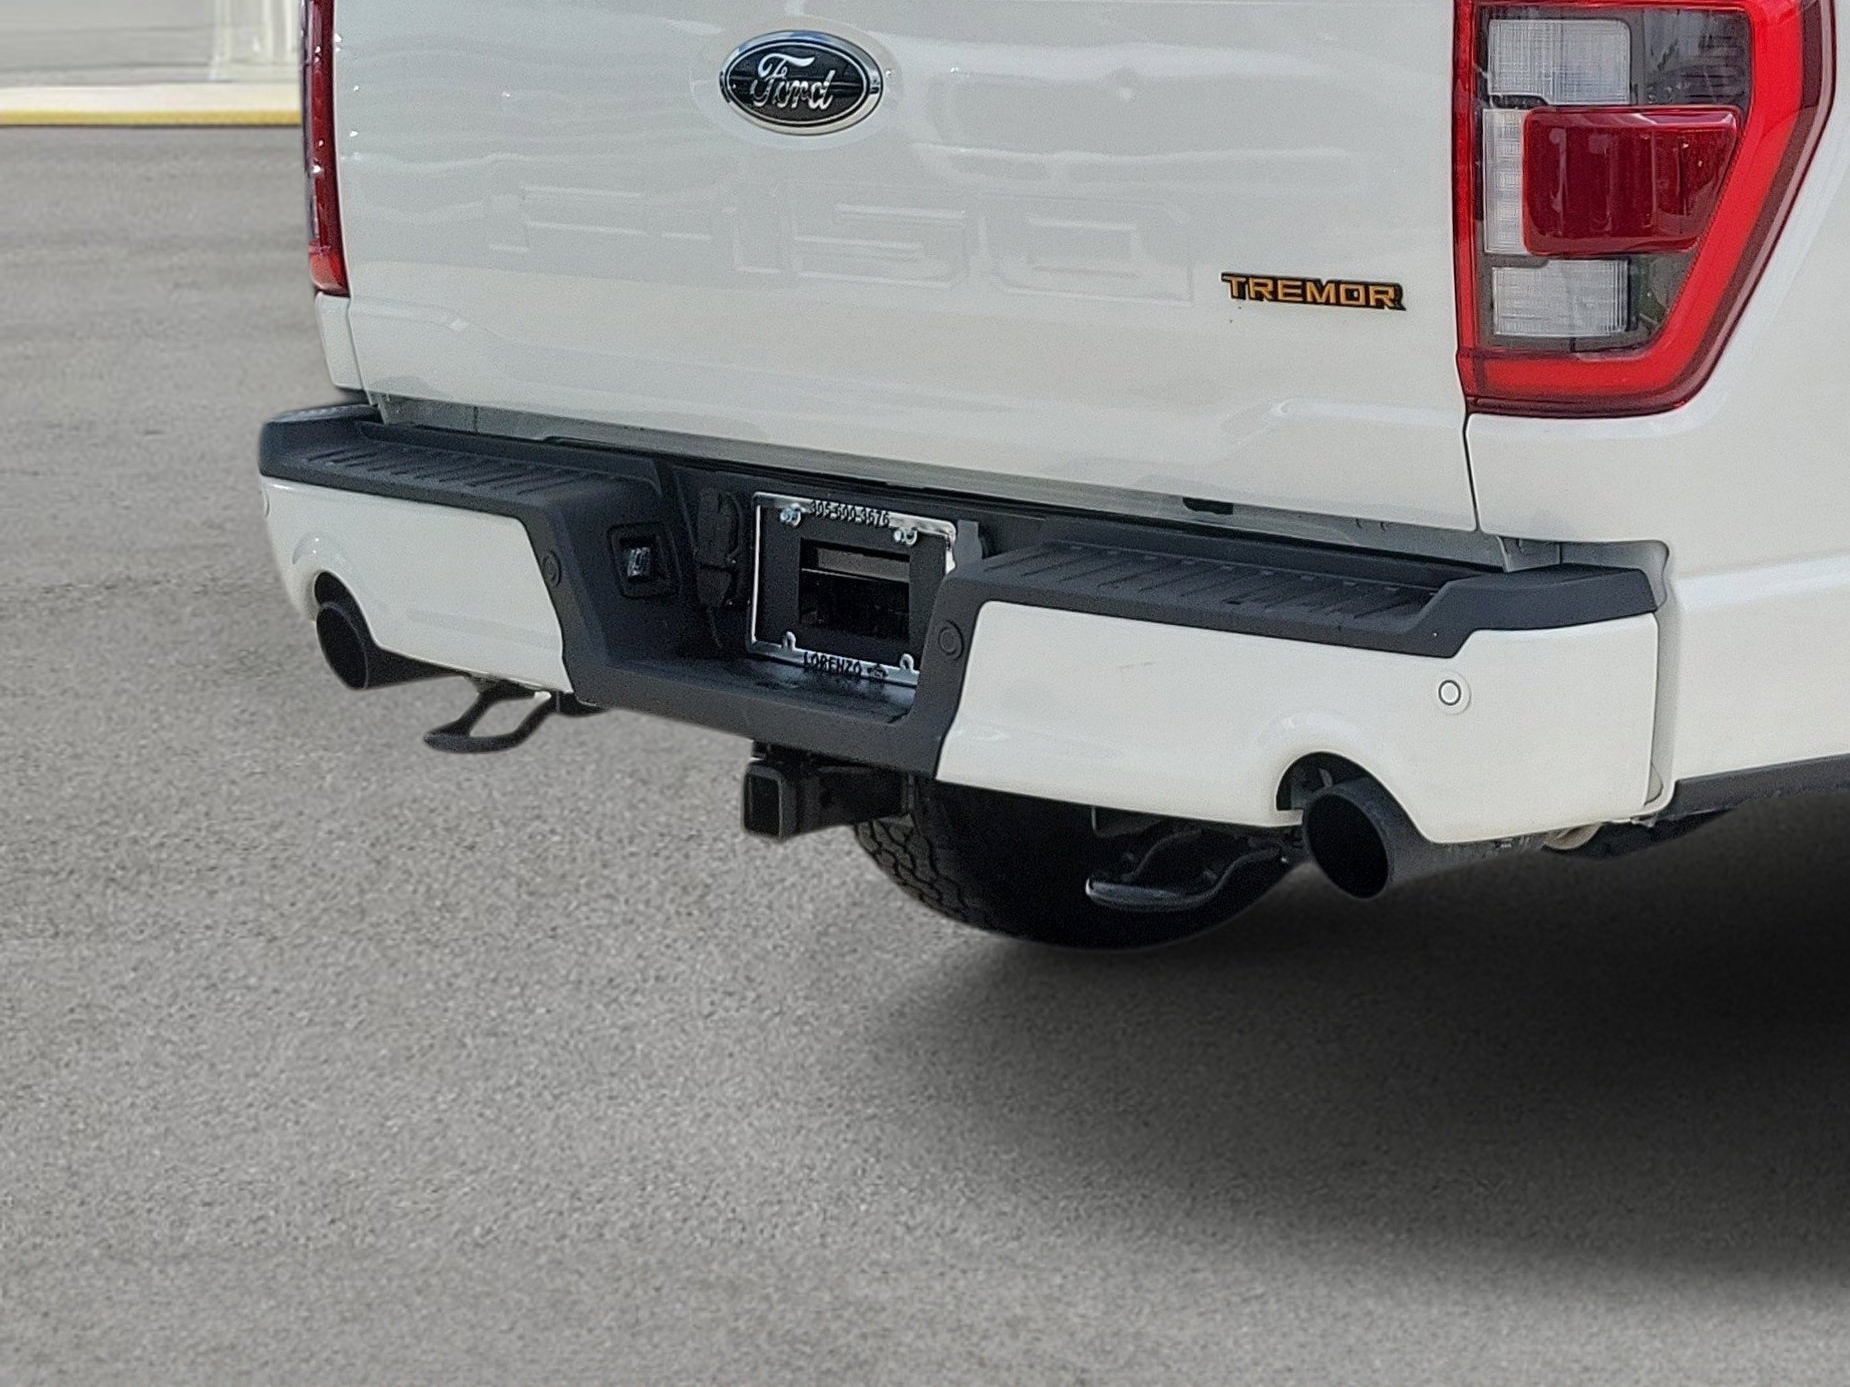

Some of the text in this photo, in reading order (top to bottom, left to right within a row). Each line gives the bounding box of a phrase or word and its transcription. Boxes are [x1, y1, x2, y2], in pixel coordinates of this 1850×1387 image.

[750, 52, 836, 110] Ford
[1220, 272, 1407, 312] TREMOR
[802, 651, 863, 679] LORENZO
